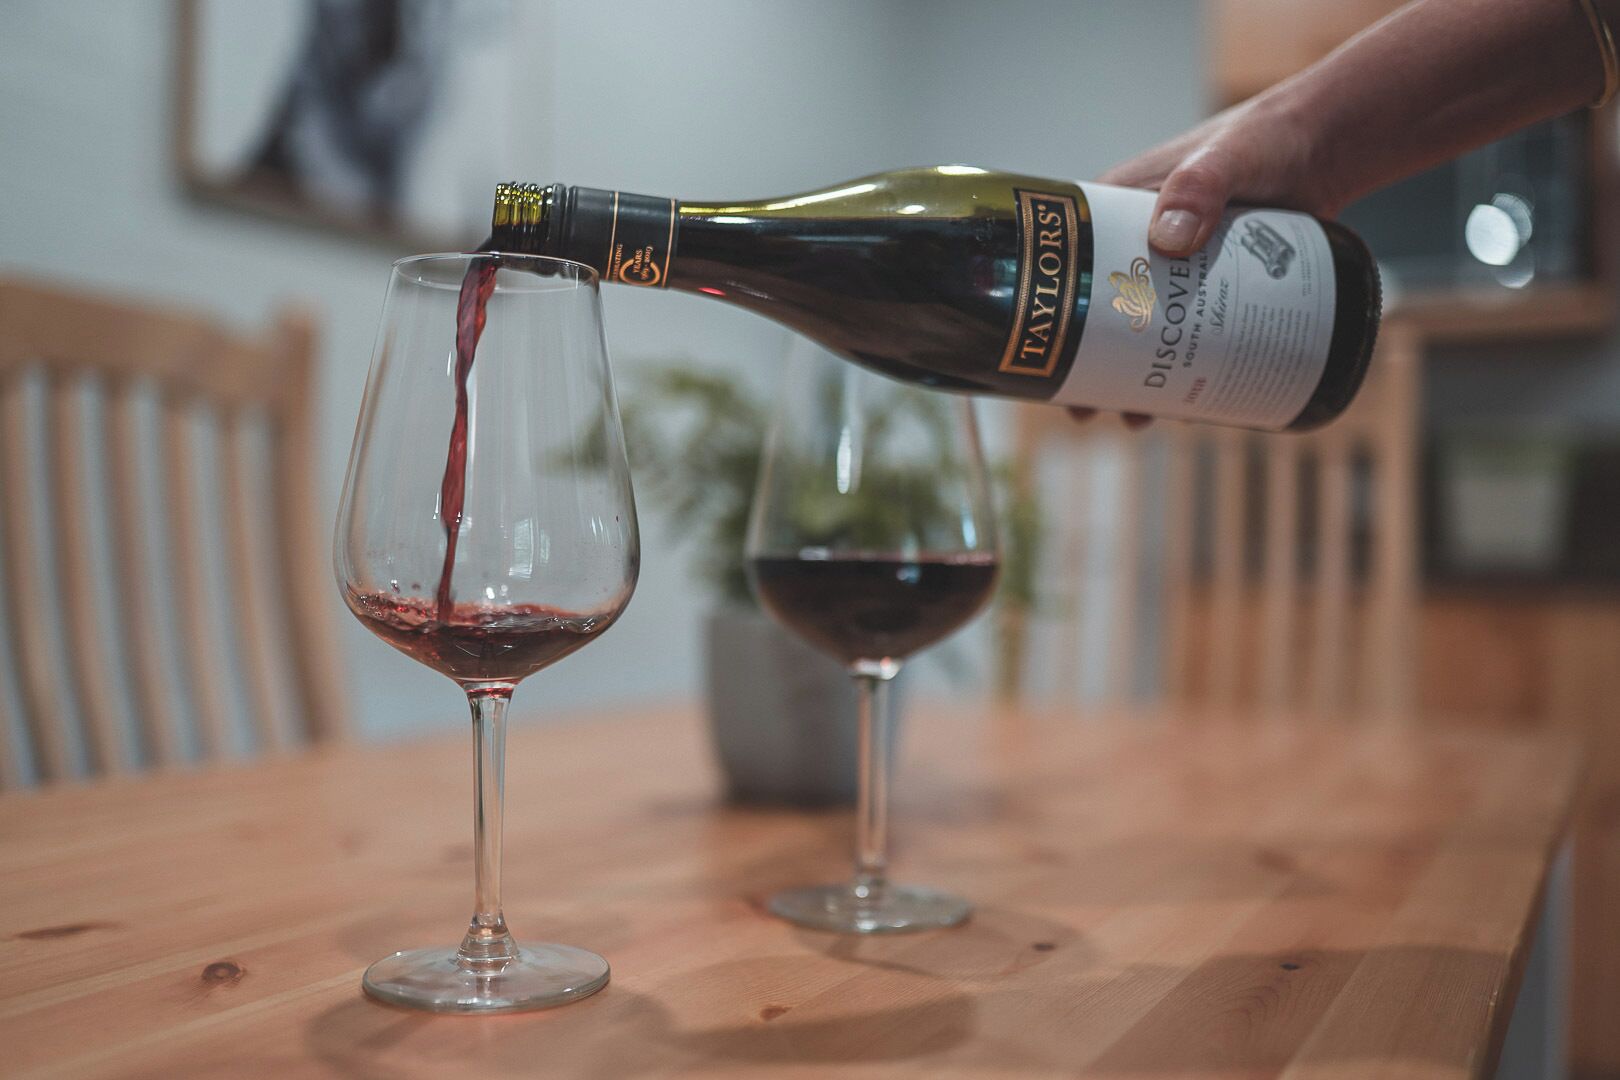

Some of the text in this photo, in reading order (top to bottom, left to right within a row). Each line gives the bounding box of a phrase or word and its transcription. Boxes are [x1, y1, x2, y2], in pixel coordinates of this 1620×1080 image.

[1183, 323, 1203, 368] SOUTH
[1196, 246, 1208, 317] AUSTRALI
[1209, 279, 1230, 337] Shiraz
